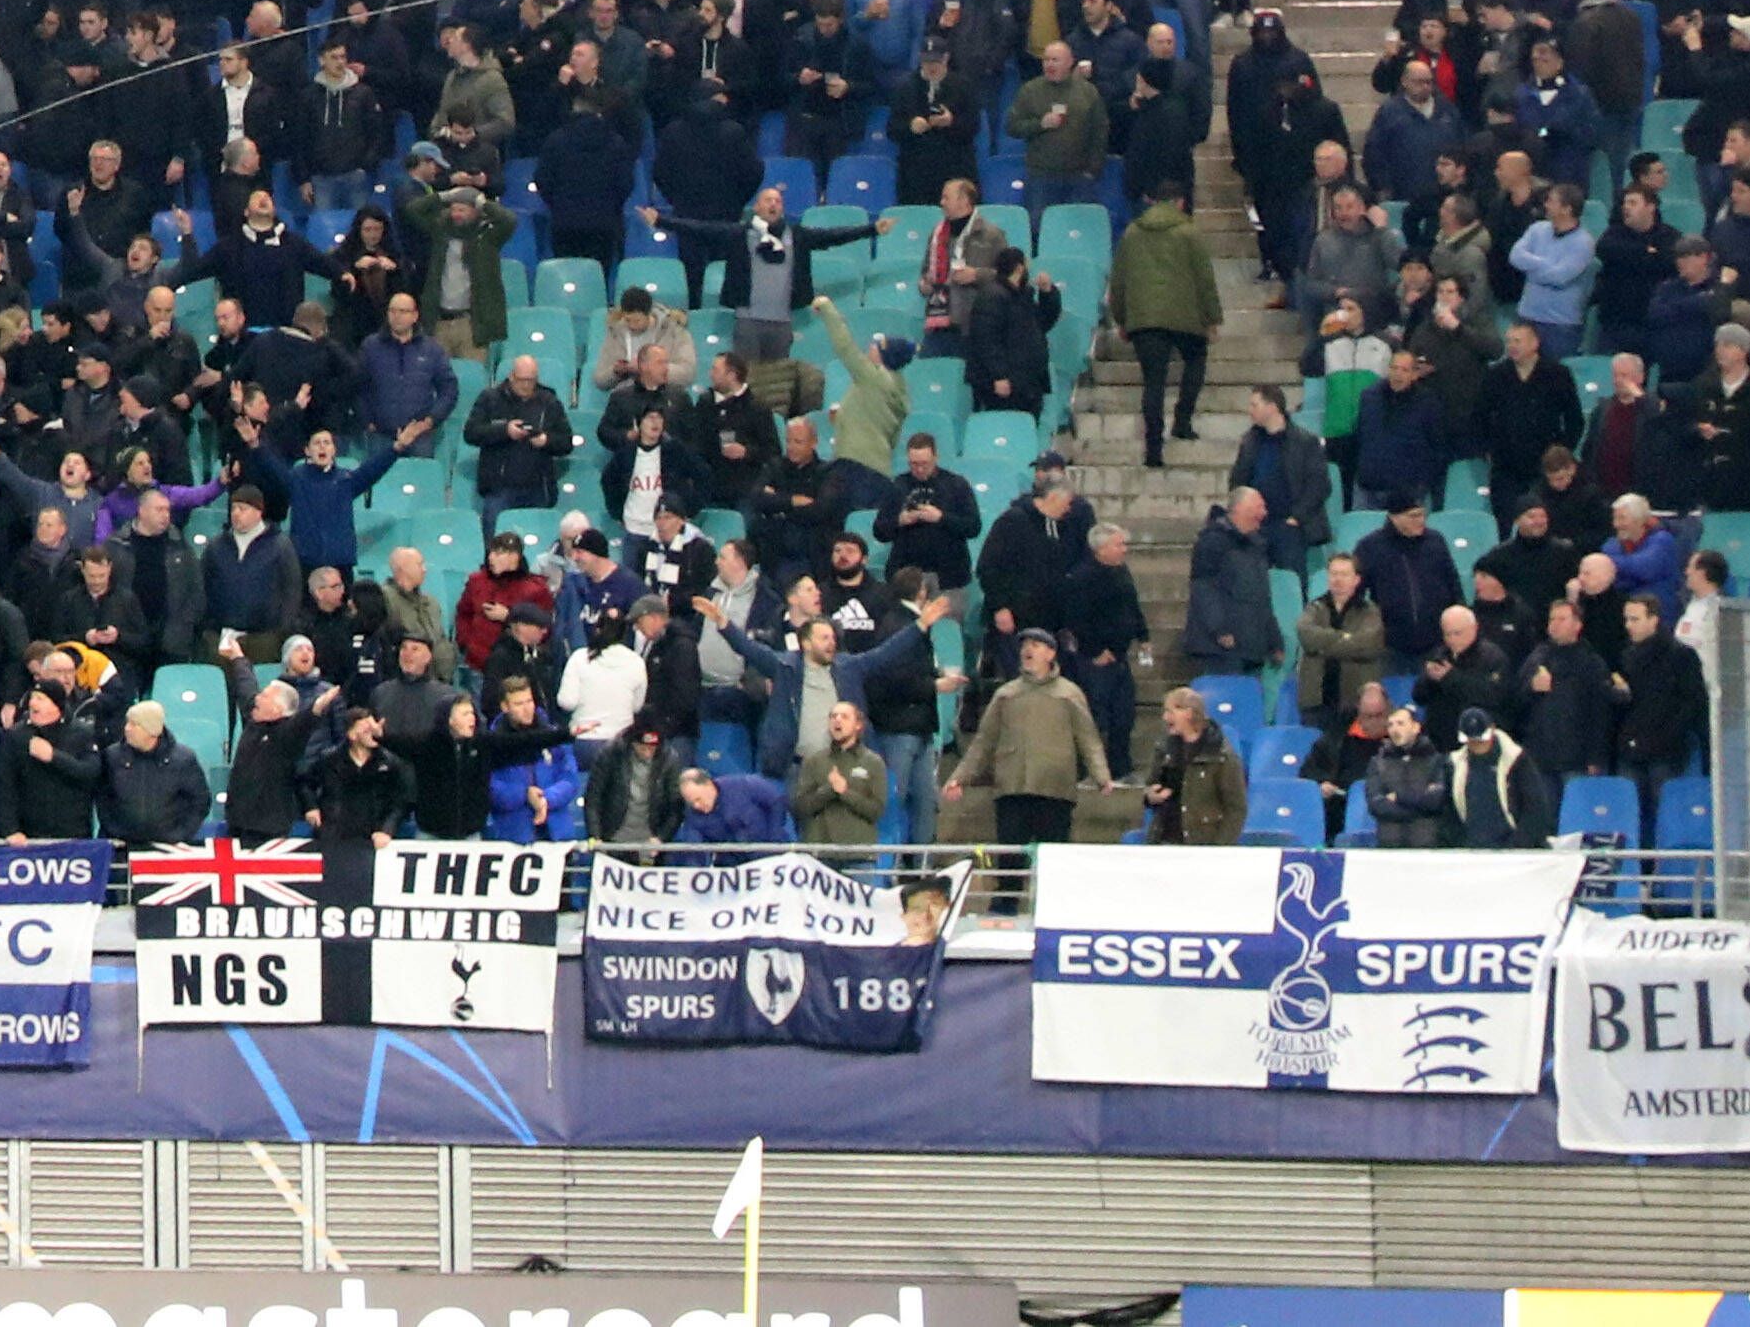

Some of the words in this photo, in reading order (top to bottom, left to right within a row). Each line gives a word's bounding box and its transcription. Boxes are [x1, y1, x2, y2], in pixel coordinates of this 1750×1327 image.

[398, 851, 544, 898] THFC
[602, 866, 679, 894] NICE
[691, 868, 761, 895] ONE
[773, 864, 876, 908] SONNY
[175, 906, 523, 942] BRAUNSCHWEIG
[597, 904, 686, 930] NICE
[712, 903, 780, 929] ONE
[805, 904, 874, 936] SON
[172, 953, 289, 1007] NGS
[603, 955, 738, 981] SWINDON
[1057, 933, 1242, 981] ESSEX
[1356, 941, 1541, 988] SPURS
[626, 994, 715, 1020] SPURS
